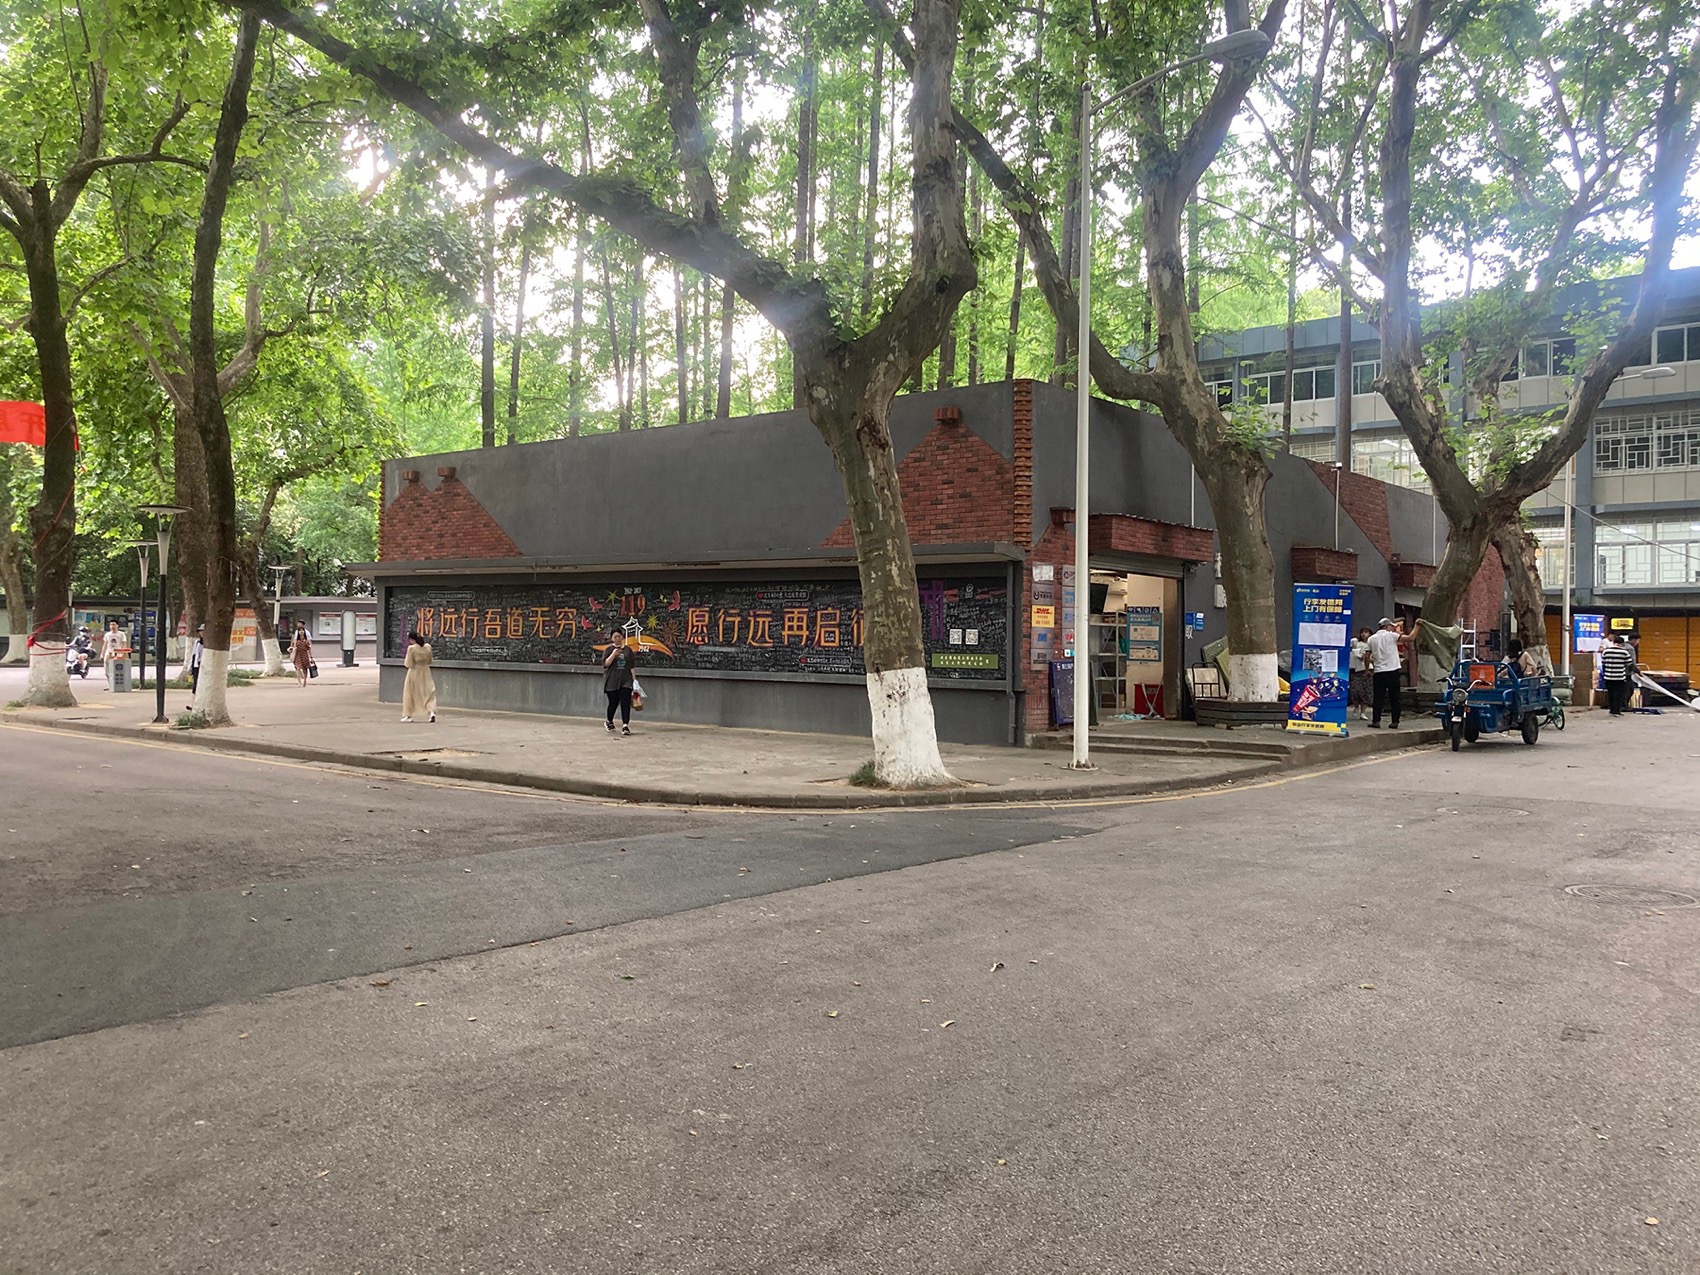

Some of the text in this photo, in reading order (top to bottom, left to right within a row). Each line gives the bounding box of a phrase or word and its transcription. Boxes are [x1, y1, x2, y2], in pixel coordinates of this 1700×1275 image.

[620, 594, 646, 616] 119
[416, 606, 577, 640] 将远行吾道无穷
